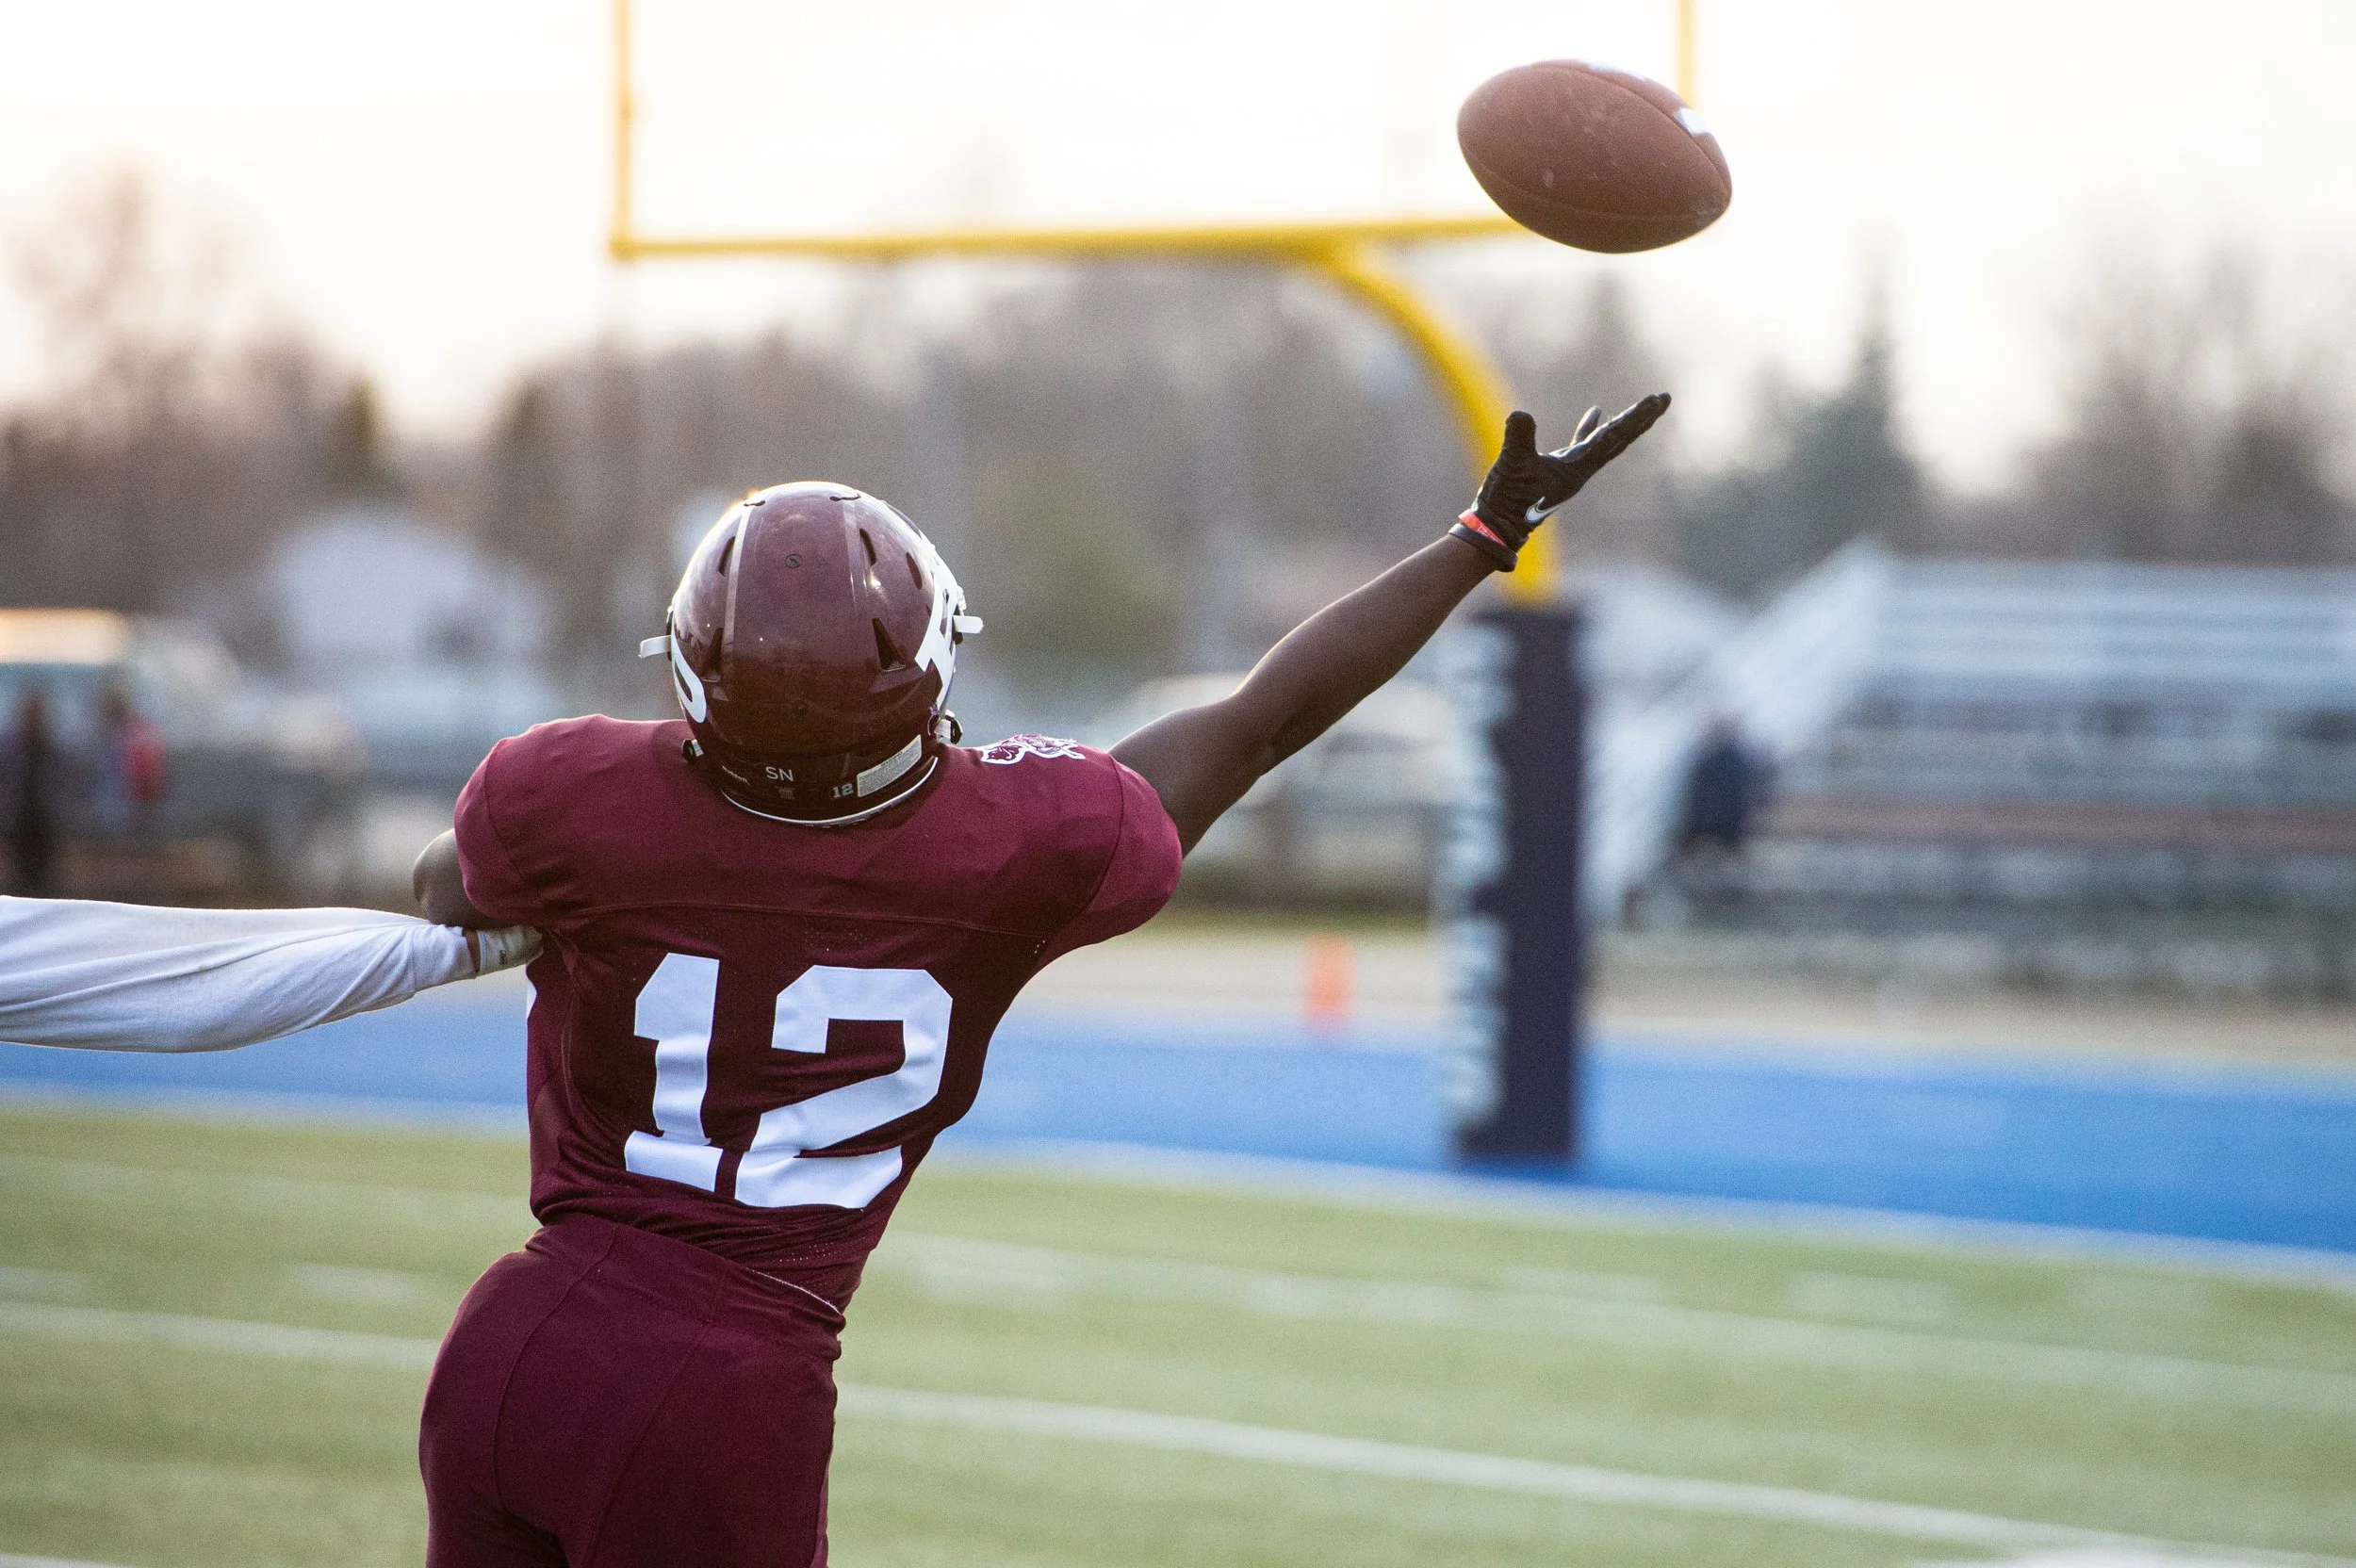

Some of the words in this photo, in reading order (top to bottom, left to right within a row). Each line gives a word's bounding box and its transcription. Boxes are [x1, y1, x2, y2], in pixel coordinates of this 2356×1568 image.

[765, 766, 794, 782] SN
[832, 783, 854, 799] 12
[624, 952, 954, 1210] 12
